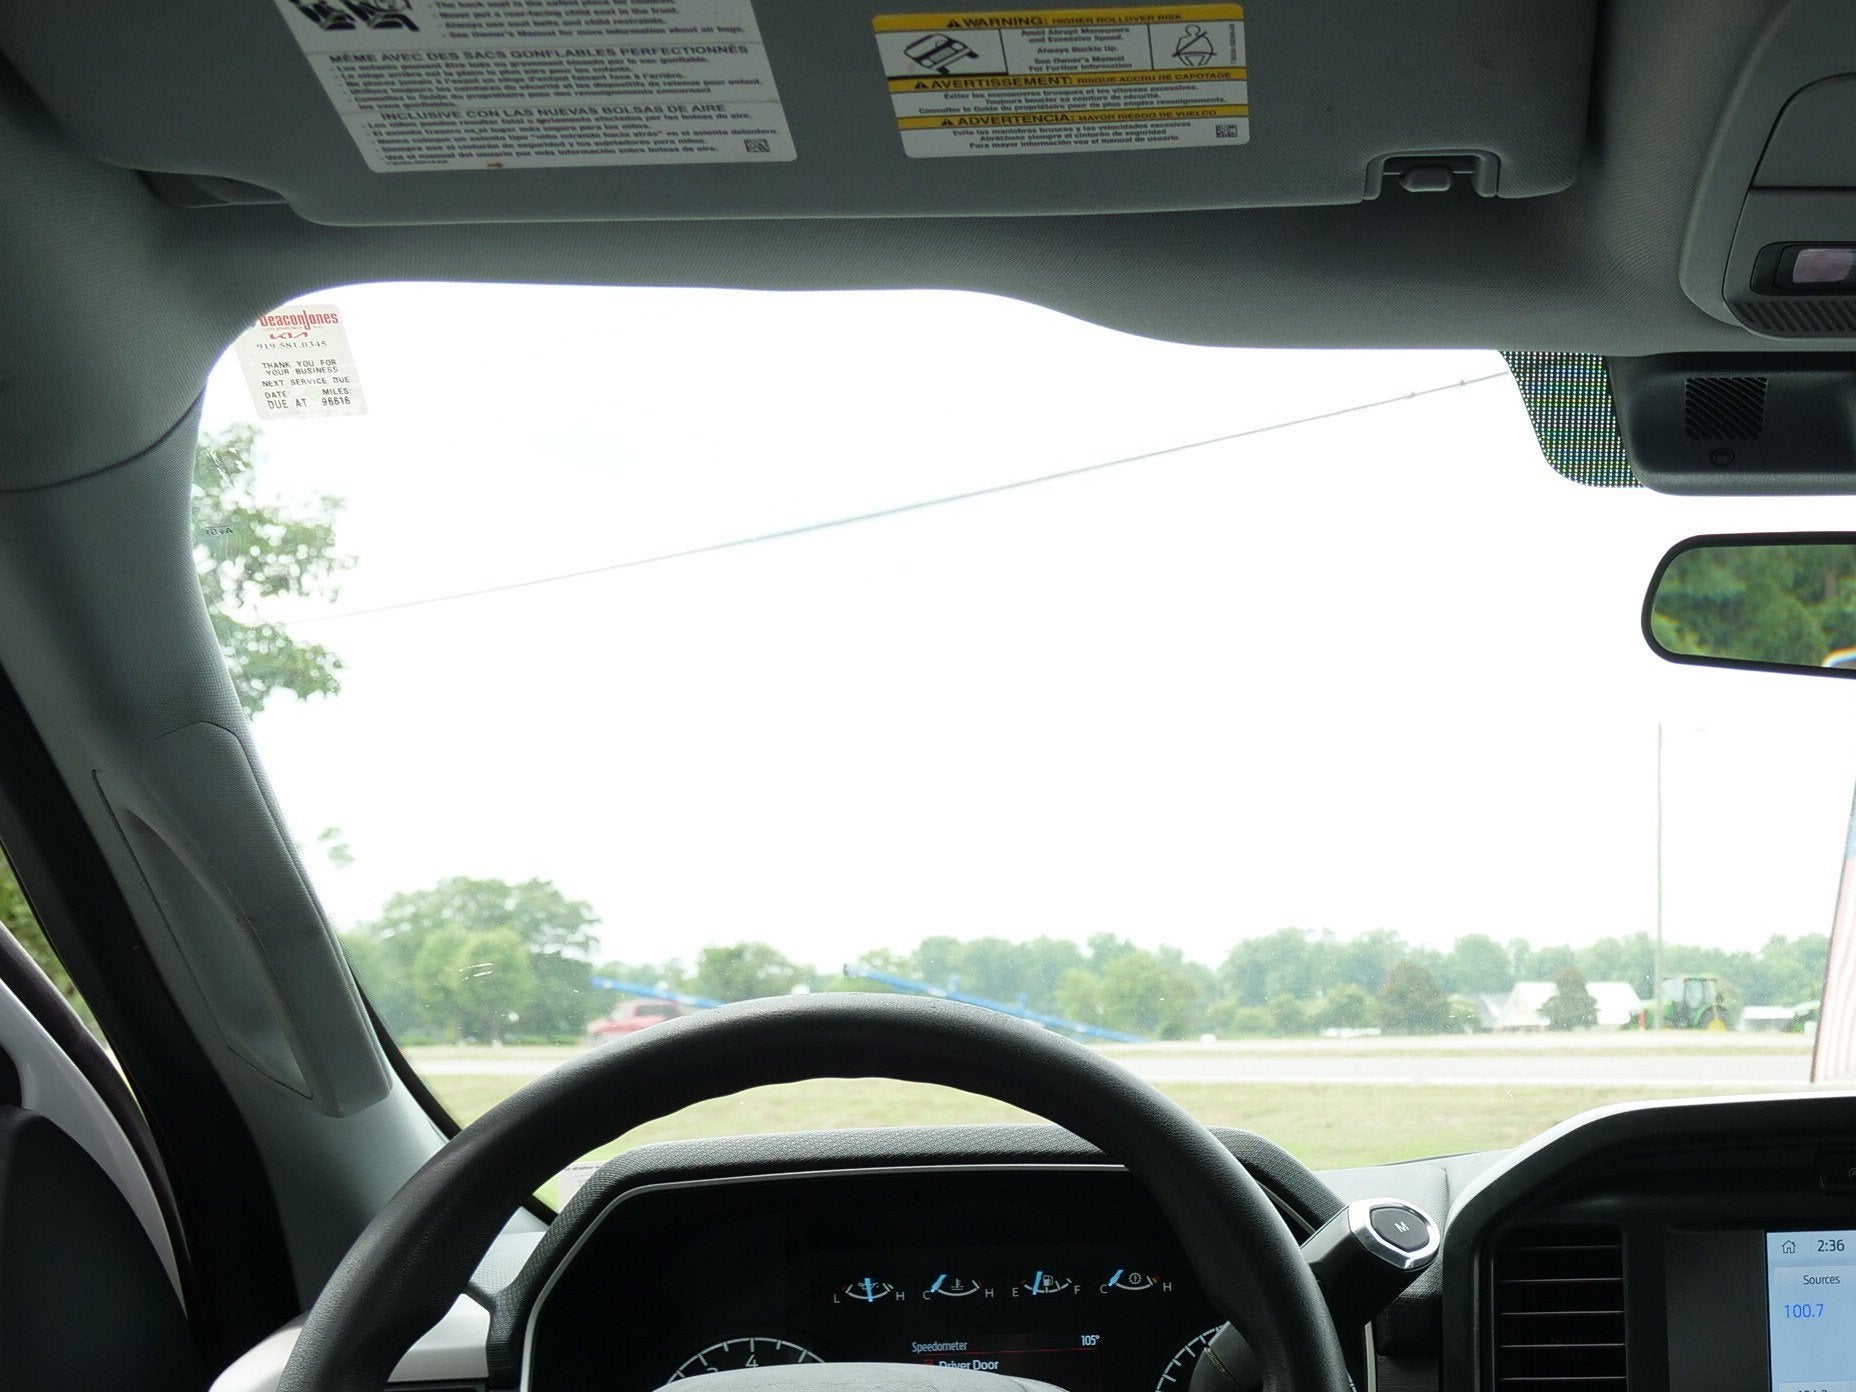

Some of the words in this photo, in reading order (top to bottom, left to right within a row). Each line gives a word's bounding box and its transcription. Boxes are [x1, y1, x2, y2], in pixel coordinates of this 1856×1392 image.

[963, 17, 1049, 28] WARNING:
[1052, 17, 1093, 25] HIGHER
[1096, 16, 1152, 24] ROLLOVER
[1156, 14, 1182, 22] RISK
[1021, 29, 1047, 37] Avoid
[1049, 28, 1078, 37] Abrupt
[1081, 27, 1130, 35] Maneuvers
[1048, 35, 1092, 43] Excessive
[382, 52, 424, 62] AVEC
[426, 51, 460, 61] DES
[463, 50, 505, 60] SACS
[510, 48, 616, 59] GONFLABLES
[1037, 47, 1069, 55] Always
[1071, 45, 1101, 53] Buckle
[1053, 56, 1089, 64] Owner's
[1091, 55, 1125, 63] Manual
[1046, 63, 1078, 71] Further
[1080, 62, 1133, 70] Information
[931, 76, 1073, 89] AVERTISSEMENT:
[380, 111, 461, 120] INCLUSIVE
[465, 110, 500, 119] CON
[502, 109, 534, 118] LAS
[537, 107, 599, 116] NUEVAS
[601, 106, 663, 115] BOLSAS
[667, 105, 688, 113] DE
[692, 104, 726, 113] AIRE
[957, 113, 1076, 125] ADVERTENCIA:
[1078, 113, 1115, 121] MAYOR
[1175, 109, 1217, 117] VUELCO
[991, 142, 1018, 150] mayor
[262, 361, 290, 369] THANK
[296, 360, 315, 368] YOU
[320, 359, 337, 367] FOR
[265, 368, 289, 376] YOUR
[295, 366, 339, 375] BUSINESS
[262, 379, 284, 387] NEXT
[290, 377, 328, 386] SERVICE
[332, 376, 350, 384] DUE
[267, 400, 289, 410] DUE
[295, 398, 307, 408] AT
[1817, 1239, 1845, 1252] 2:36
[1803, 1274, 1840, 1286] Sources
[922, 1290, 931, 1300] C
[985, 1287, 994, 1298] H
[1012, 1287, 1019, 1297] E
[1074, 1285, 1081, 1295] F
[1100, 1284, 1108, 1294] C
[1163, 1282, 1172, 1292] H
[833, 1293, 840, 1304] L
[896, 1291, 905, 1301] H
[1784, 1303, 1824, 1318] 100.7
[912, 1340, 968, 1354] Speedometer
[1081, 1334, 1100, 1346] 105°
[745, 1354, 759, 1369] 4
[973, 1359, 999, 1371] Door
